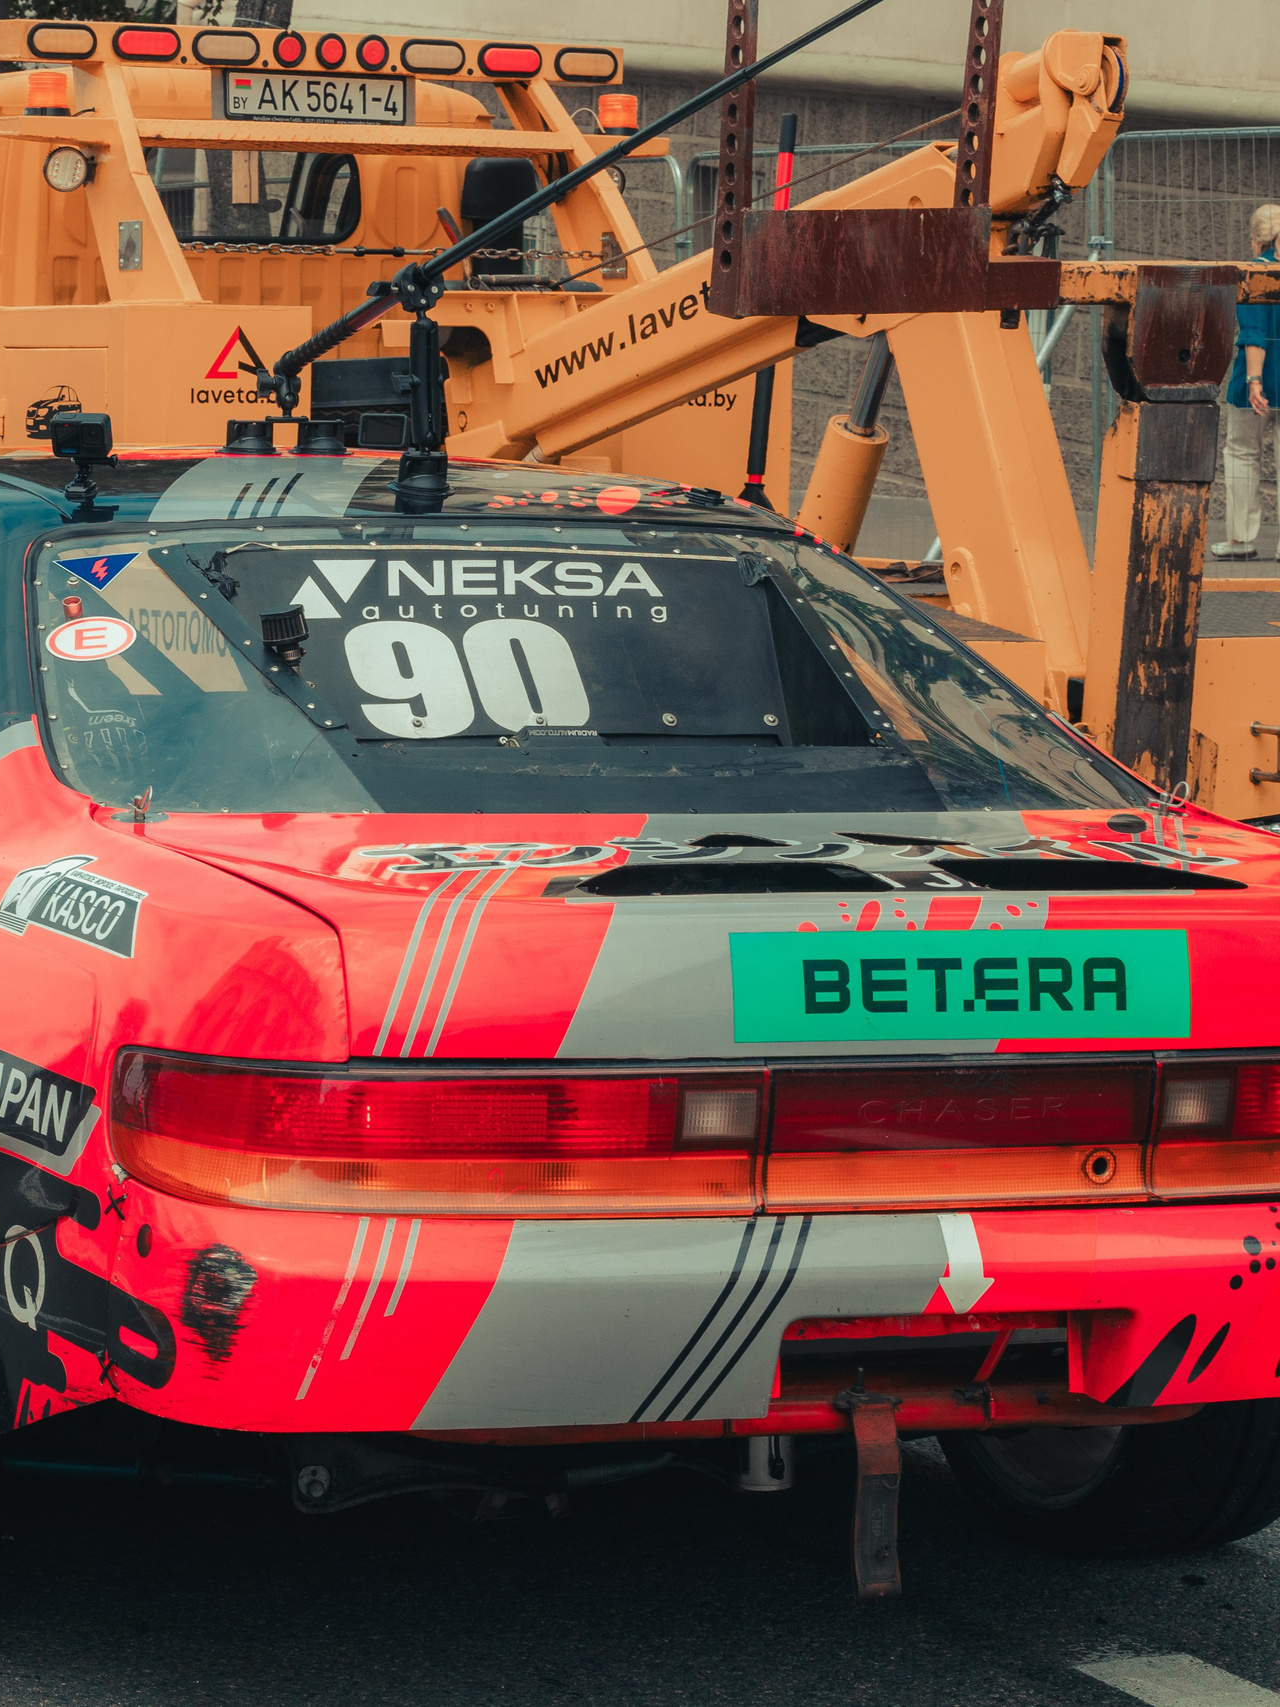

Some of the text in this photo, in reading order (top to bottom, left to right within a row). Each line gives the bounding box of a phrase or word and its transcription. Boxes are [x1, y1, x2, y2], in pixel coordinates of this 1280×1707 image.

[233, 78, 398, 116] BY AK 5641-4
[387, 559, 664, 597] NEKSA
[361, 601, 669, 623] autotuning
[74, 627, 108, 650] E
[343, 618, 590, 740] 90
[40, 880, 126, 941] KASCO
[858, 1097, 1071, 1124] CHASER
